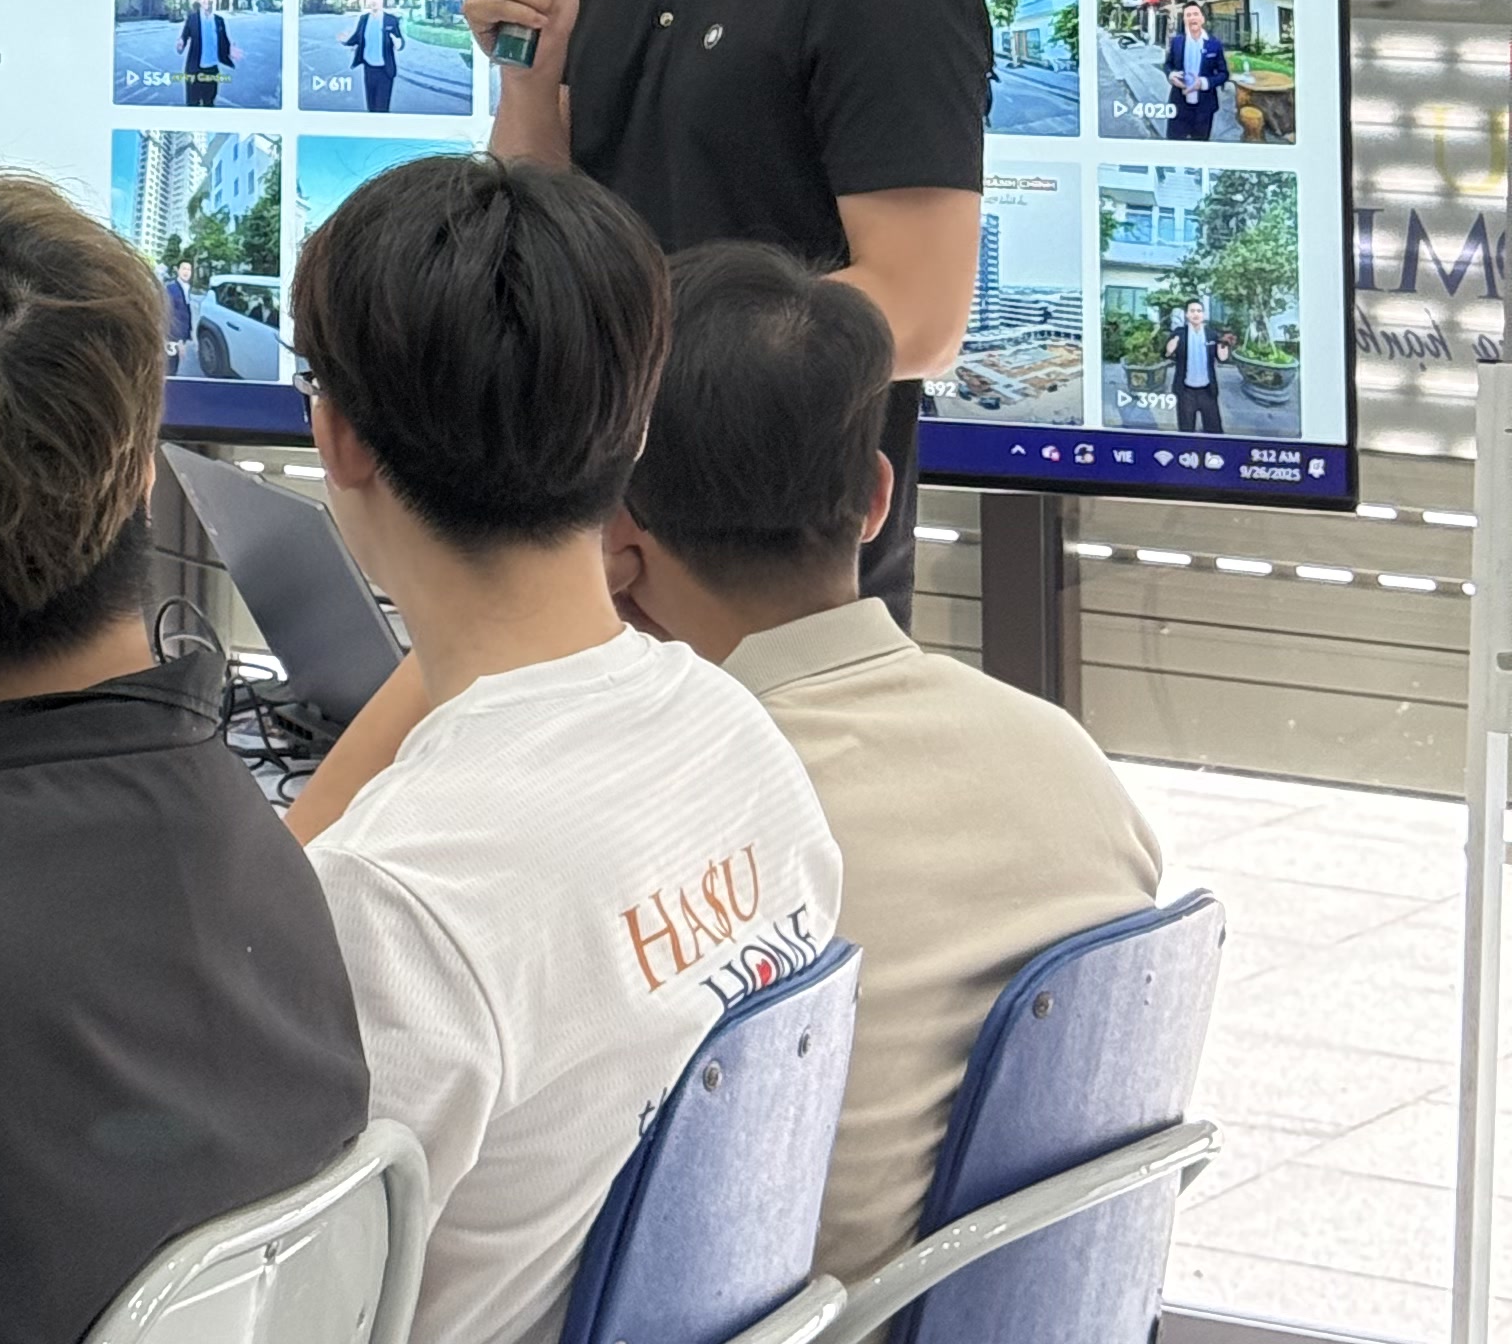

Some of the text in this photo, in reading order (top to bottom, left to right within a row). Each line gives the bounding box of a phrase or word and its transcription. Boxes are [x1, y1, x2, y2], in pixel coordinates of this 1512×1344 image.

[142, 70, 172, 87] 554
[1136, 391, 1178, 410] 3919
[1112, 449, 1135, 464] VIE
[1278, 449, 1301, 464] AM
